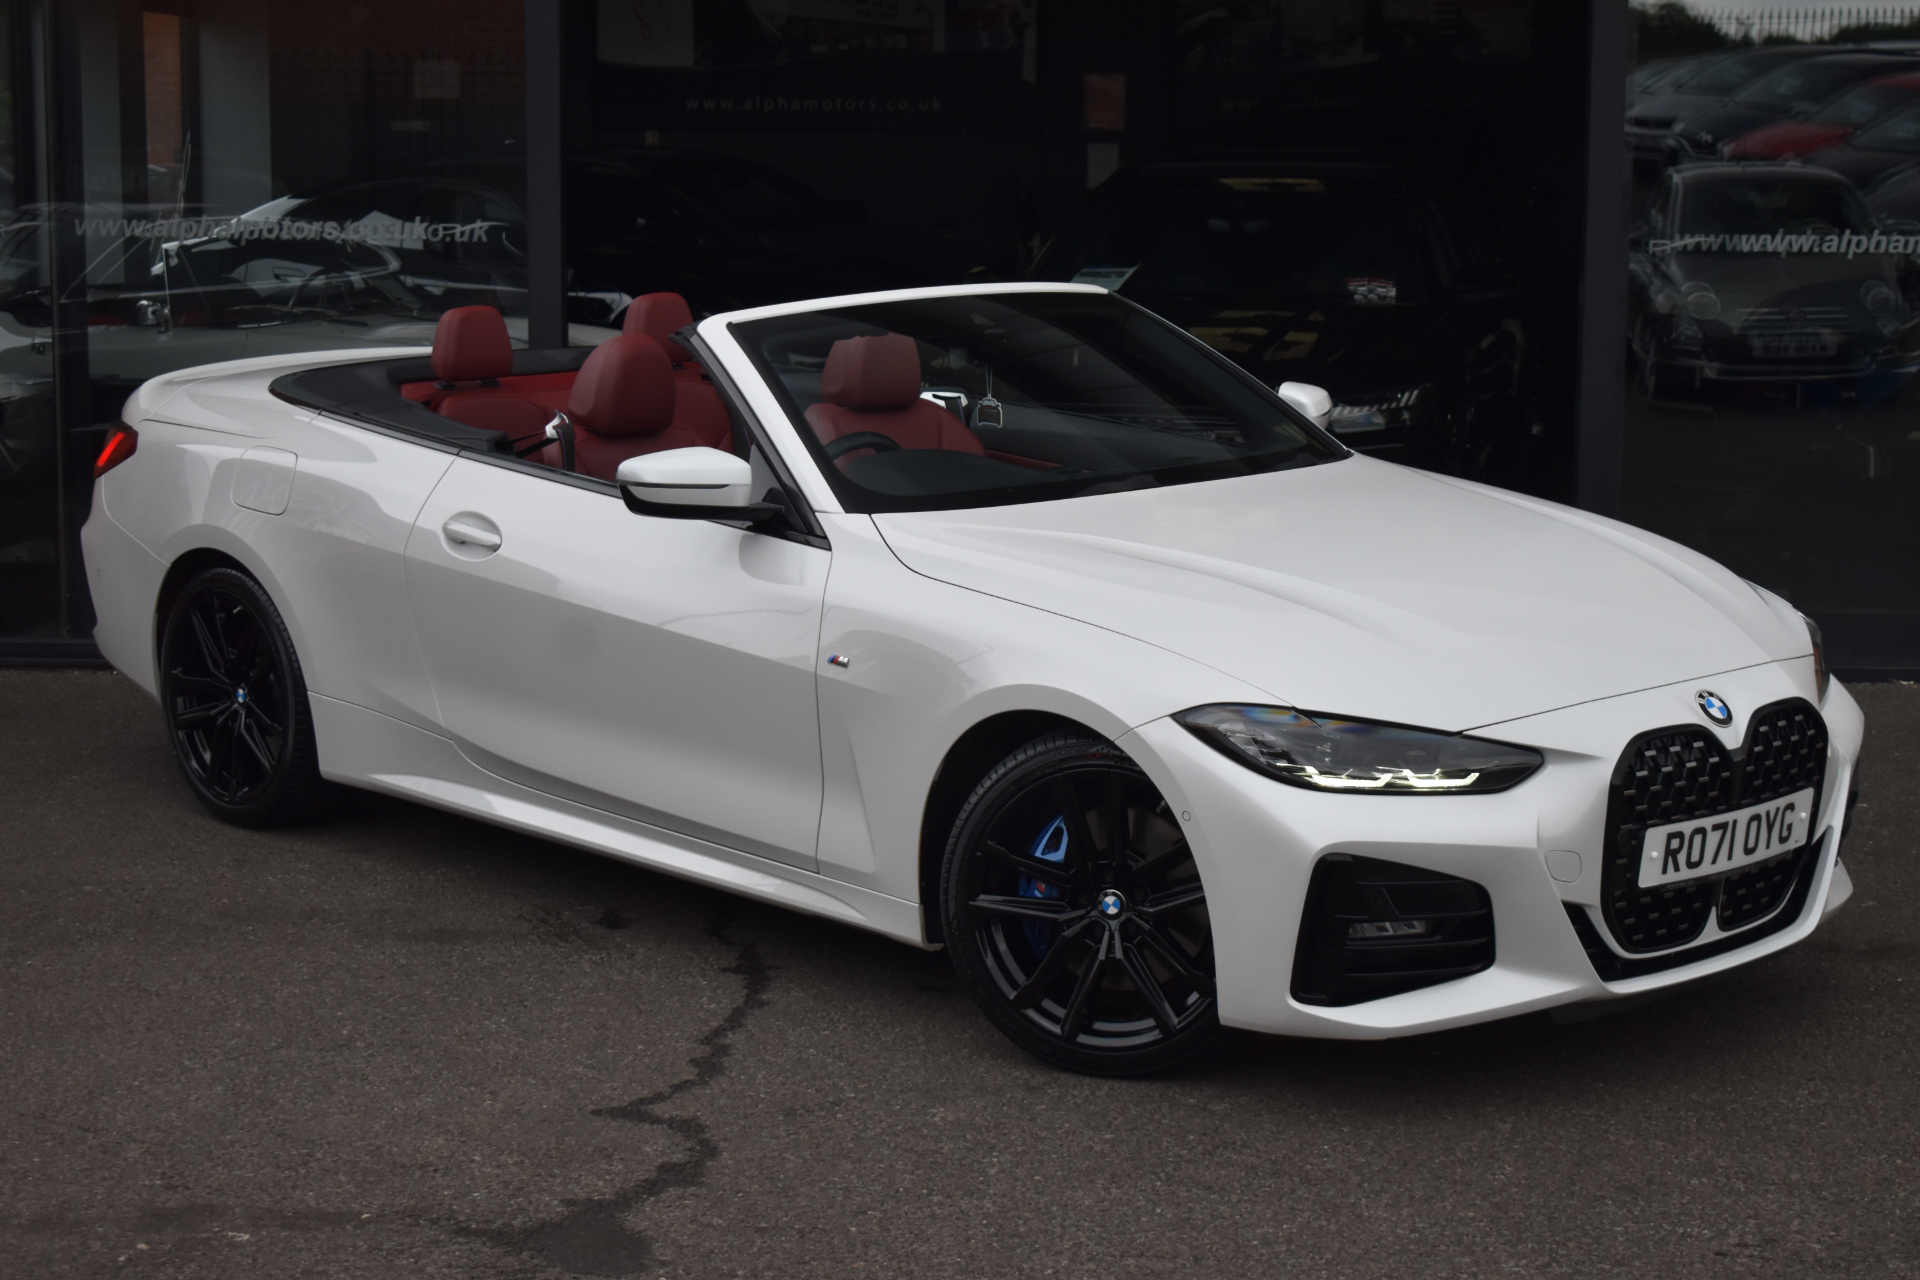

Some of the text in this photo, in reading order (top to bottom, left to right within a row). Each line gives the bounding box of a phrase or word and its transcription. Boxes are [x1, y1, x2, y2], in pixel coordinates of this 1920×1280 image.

[685, 95, 942, 113] www.alphamotors.co.uk
[1661, 802, 1796, 875] RO71 OYG
